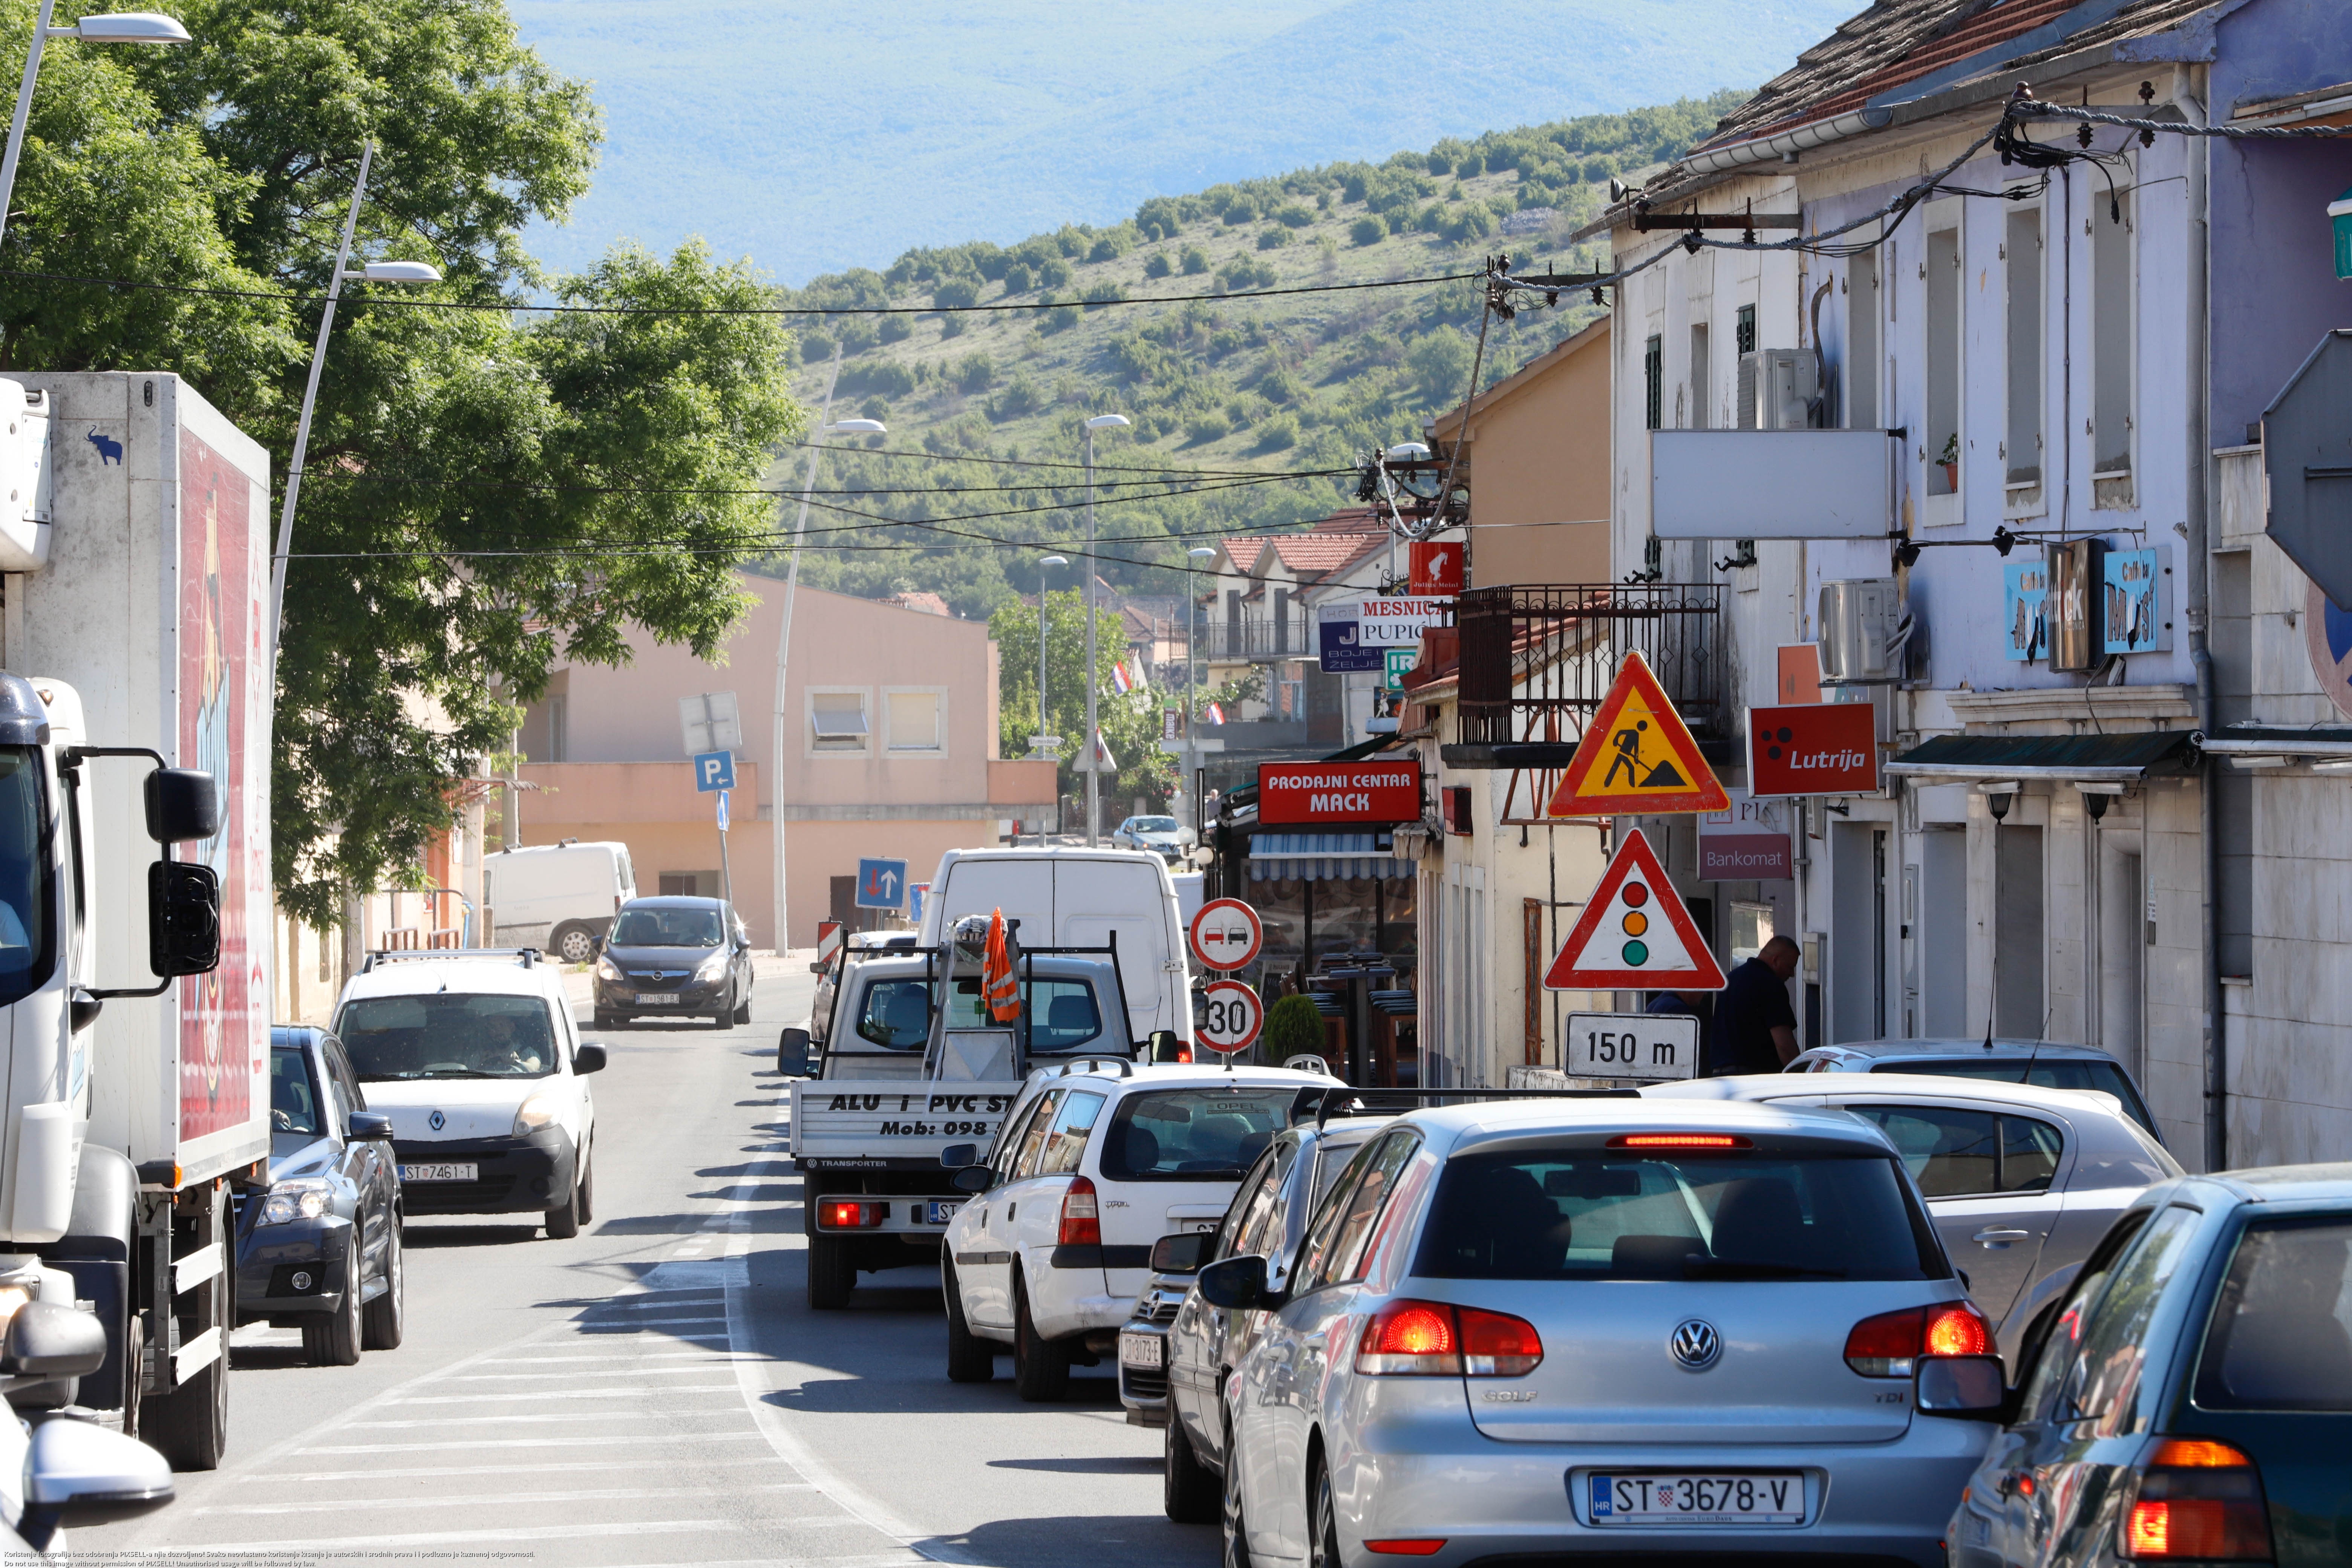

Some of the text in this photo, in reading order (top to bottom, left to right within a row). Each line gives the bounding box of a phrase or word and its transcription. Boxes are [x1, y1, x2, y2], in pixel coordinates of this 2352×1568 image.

[1363, 600, 1448, 616] MESNICA
[1329, 649, 1372, 658] BOJE
[1329, 660, 1384, 669] ŽELJE
[1790, 749, 1865, 772] Lutrija
[704, 759, 721, 784] P
[1269, 773, 1410, 790] PRODAJNI CENTAR
[1310, 793, 1369, 812] MACK
[1707, 850, 1782, 866] Bankomat
[1208, 1001, 1246, 1035] 30
[1588, 1032, 1675, 1064] 150 m
[828, 1094, 881, 1110] ALU
[900, 1095, 910, 1112] i
[929, 1095, 978, 1112] PVC
[880, 1121, 936, 1135] Mob:
[944, 1122, 987, 1135] 098
[407, 1166, 471, 1179] ST 7461-T
[940, 1205, 957, 1219] ST
[1125, 1338, 1158, 1362] ST 3173-E
[1481, 1390, 1538, 1402] GOLF
[1616, 1479, 1788, 1512] ST 3678-V
[1595, 1501, 1610, 1511] HR
